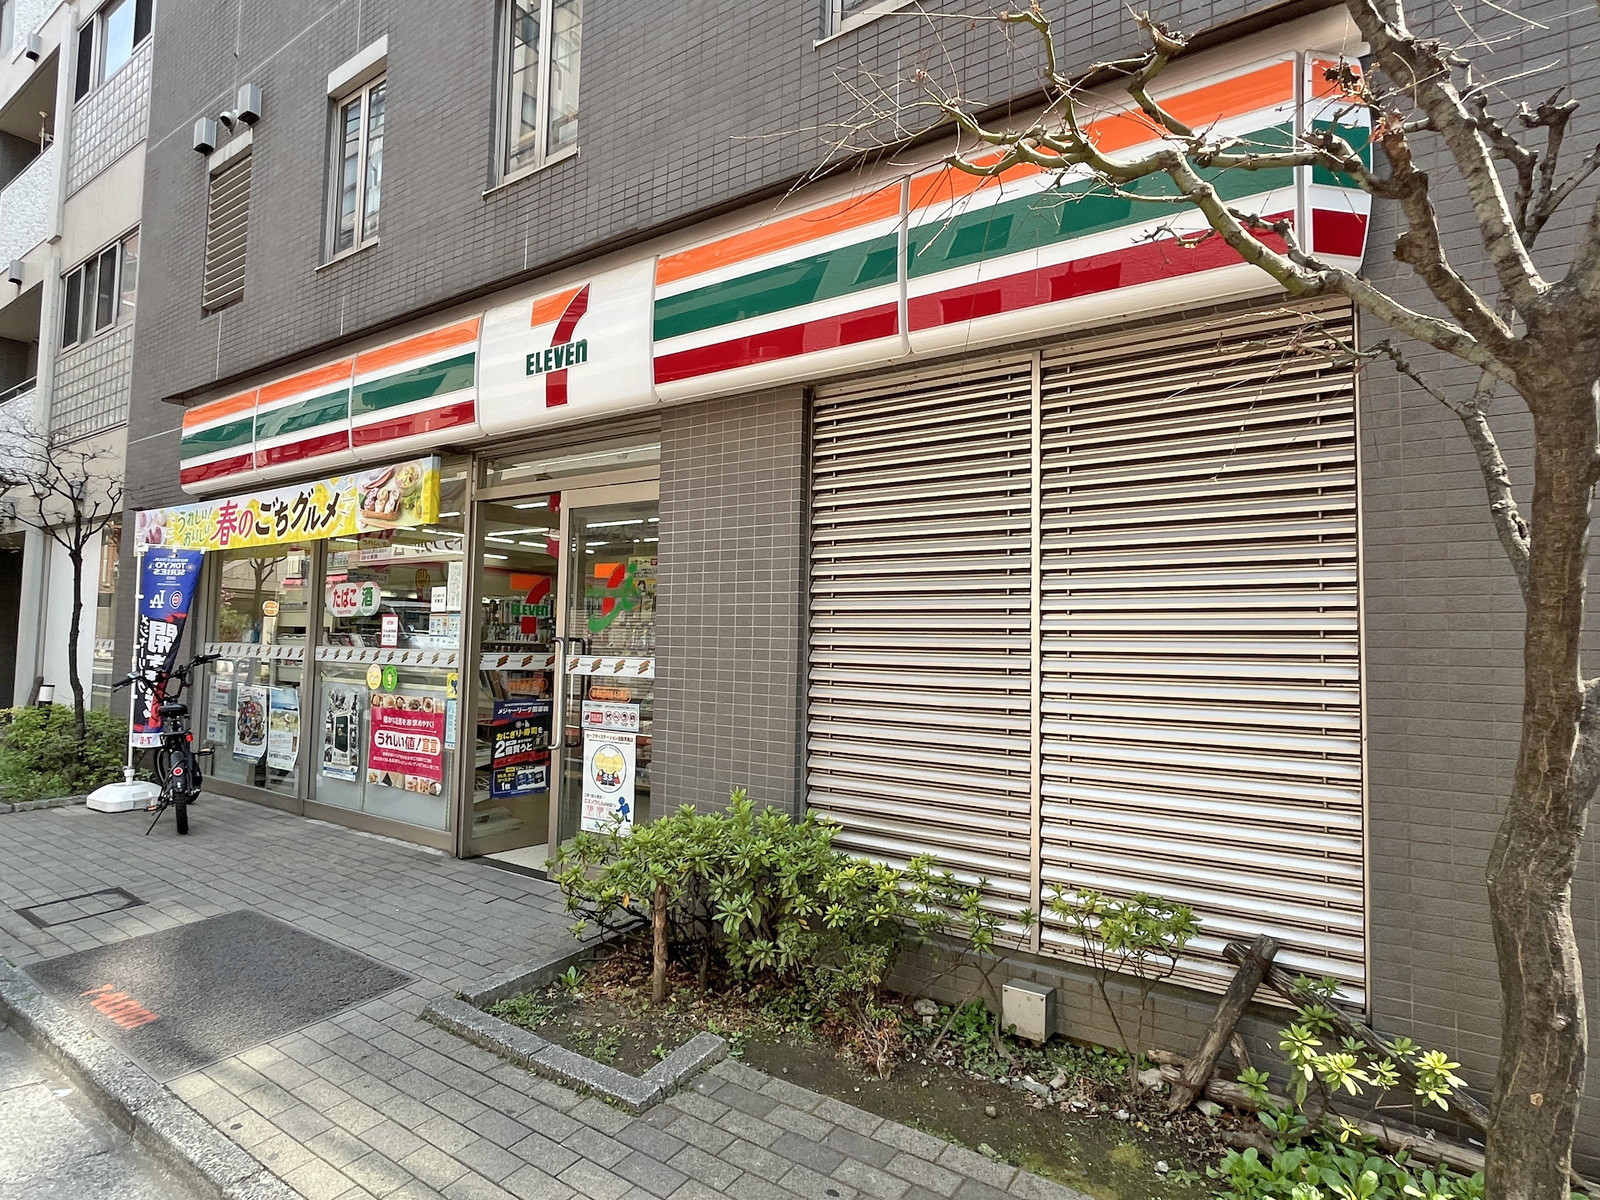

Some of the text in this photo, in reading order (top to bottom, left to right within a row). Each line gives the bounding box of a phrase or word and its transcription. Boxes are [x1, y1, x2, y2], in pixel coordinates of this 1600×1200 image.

[531, 282, 589, 407] 7
[209, 488, 341, 546] 春のごちグルメ
[332, 588, 357, 609] たばこ
[361, 586, 374, 608] 酒
